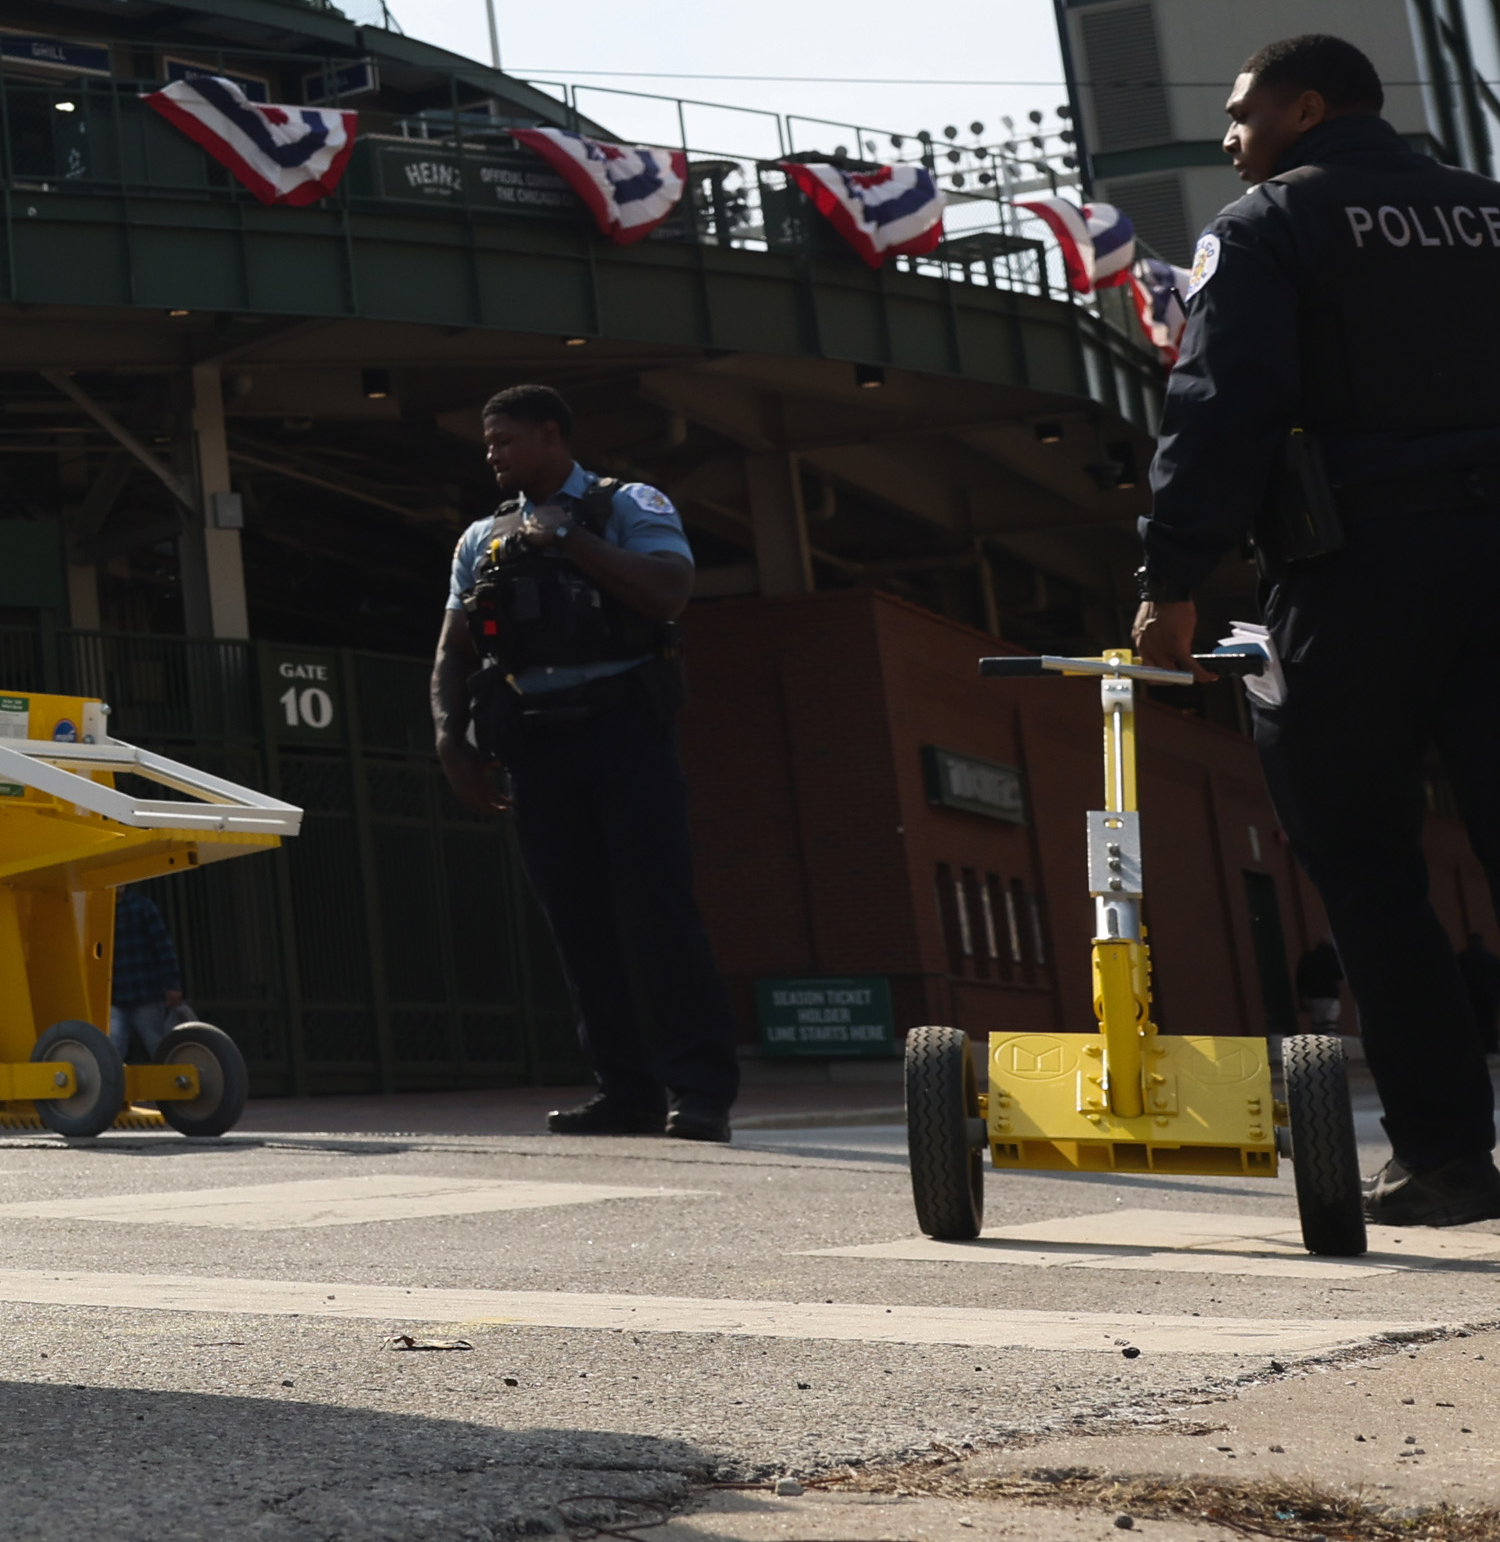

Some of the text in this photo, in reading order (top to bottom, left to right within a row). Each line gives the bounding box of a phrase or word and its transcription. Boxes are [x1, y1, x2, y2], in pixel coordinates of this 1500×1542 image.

[31, 42, 67, 61] GRILL
[1345, 205, 1500, 248] POLICE
[279, 662, 329, 681] GATE
[279, 685, 334, 729] 10
[772, 989, 872, 1007] SEASON TICKET
[797, 1007, 851, 1024] HOLDER
[766, 1025, 887, 1042] LINE STARTS HERE
